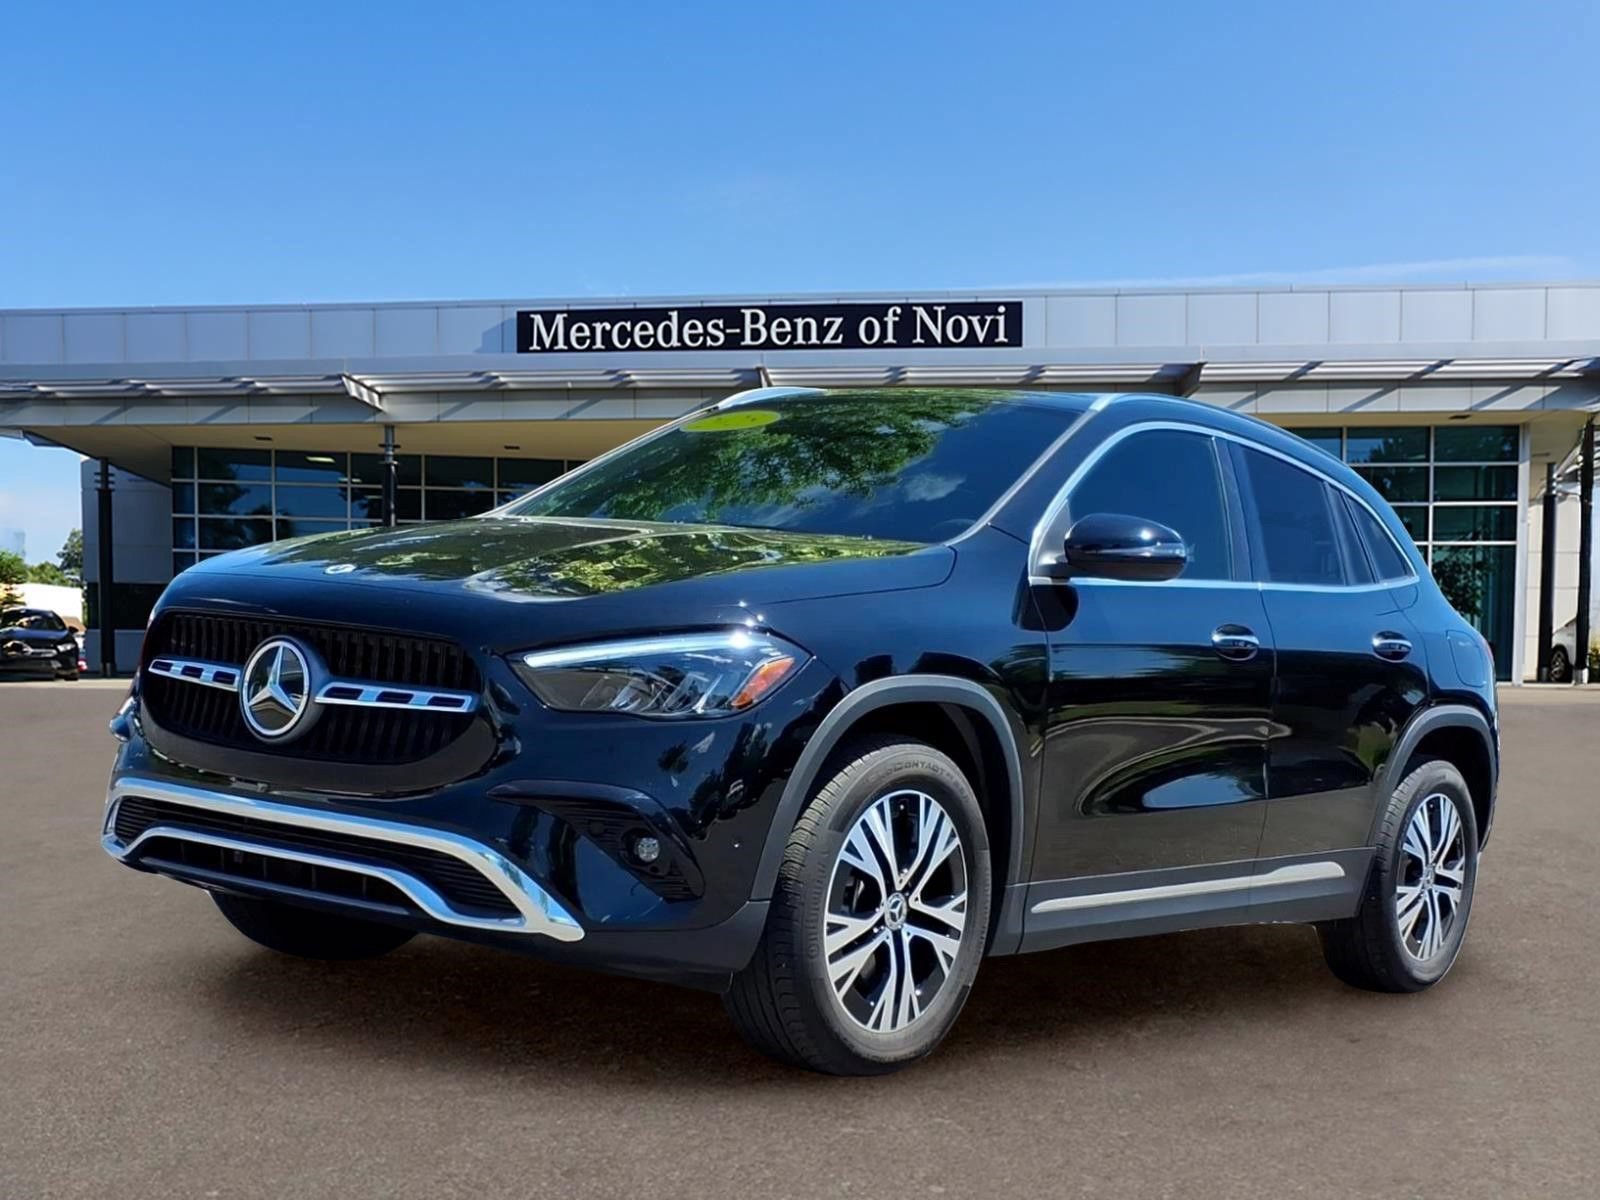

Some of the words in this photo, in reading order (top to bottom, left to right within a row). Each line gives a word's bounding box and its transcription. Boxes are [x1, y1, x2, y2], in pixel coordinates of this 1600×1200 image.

[529, 308, 843, 351] Mercedes-Benz
[858, 306, 902, 345] of
[912, 305, 1009, 344] Novi
